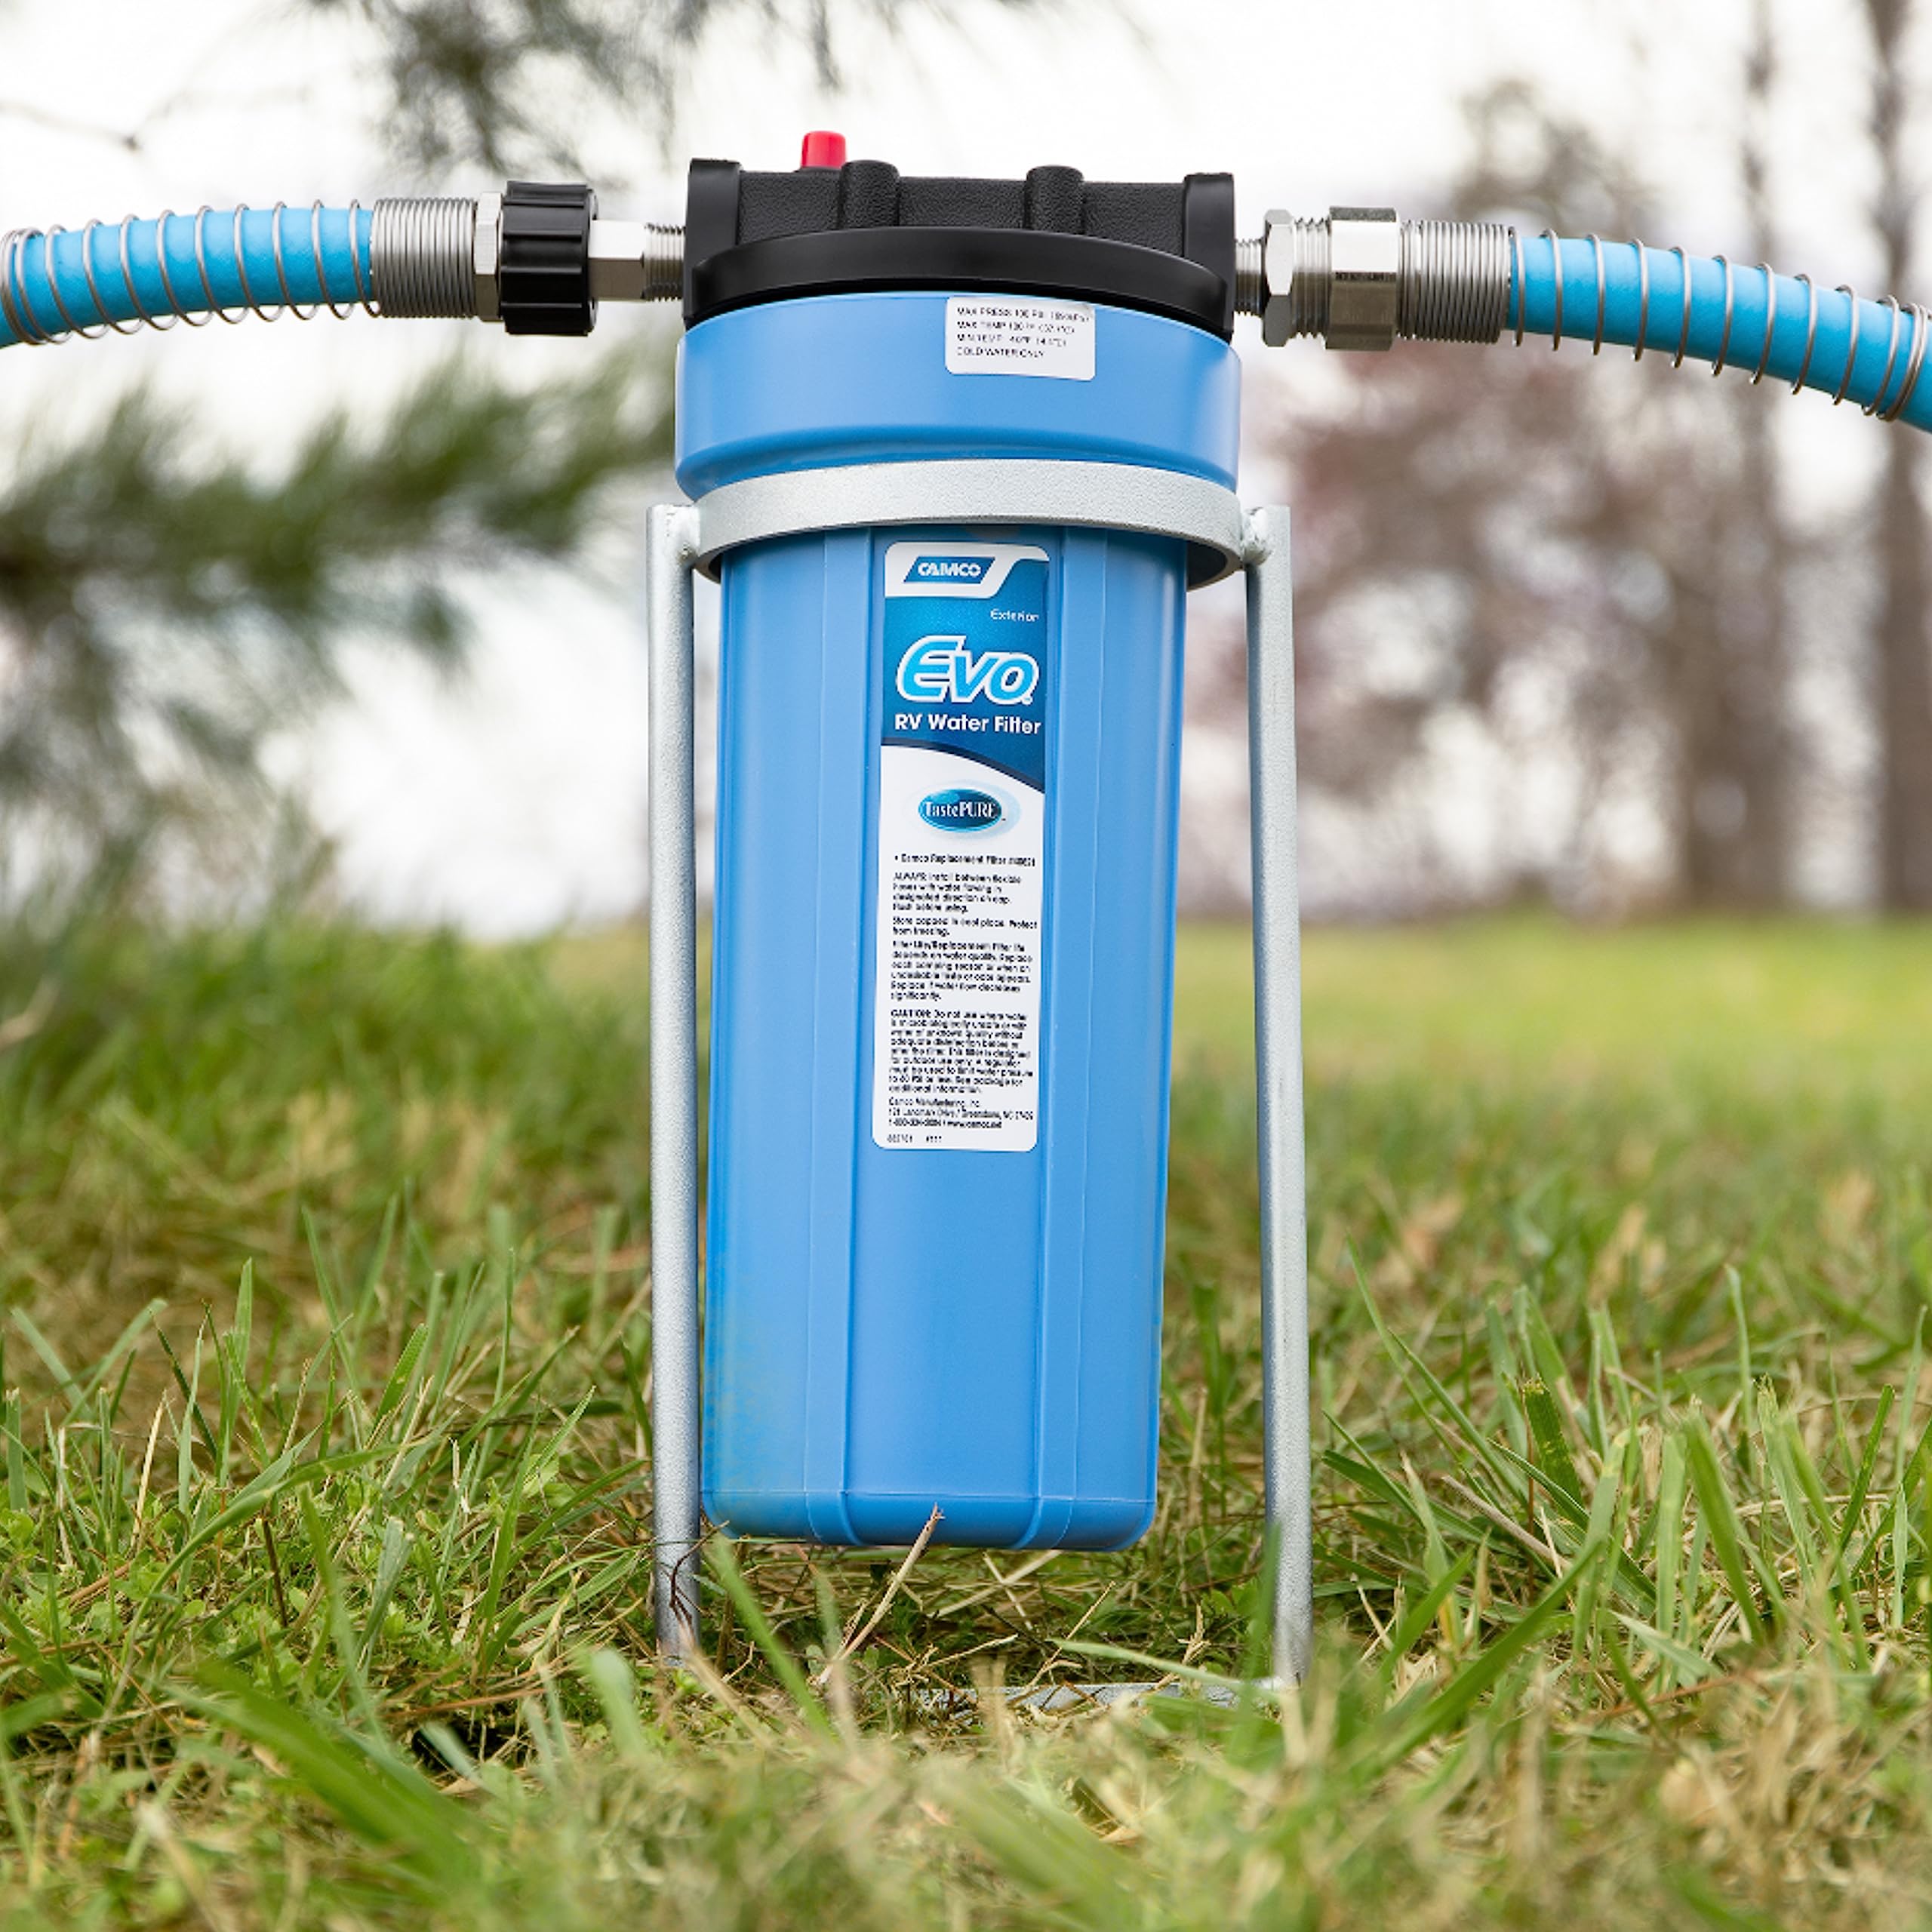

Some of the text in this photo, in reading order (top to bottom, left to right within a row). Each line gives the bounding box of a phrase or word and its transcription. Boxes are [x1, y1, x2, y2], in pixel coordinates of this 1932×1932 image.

[957, 347, 1045, 358] COLD WATER ONLY
[918, 561, 982, 577] CAMCO
[990, 608, 1040, 623] Exterior
[896, 635, 1040, 705] Evo
[894, 712, 1041, 735] RV Water Filter
[925, 801, 997, 818] TastePURE
